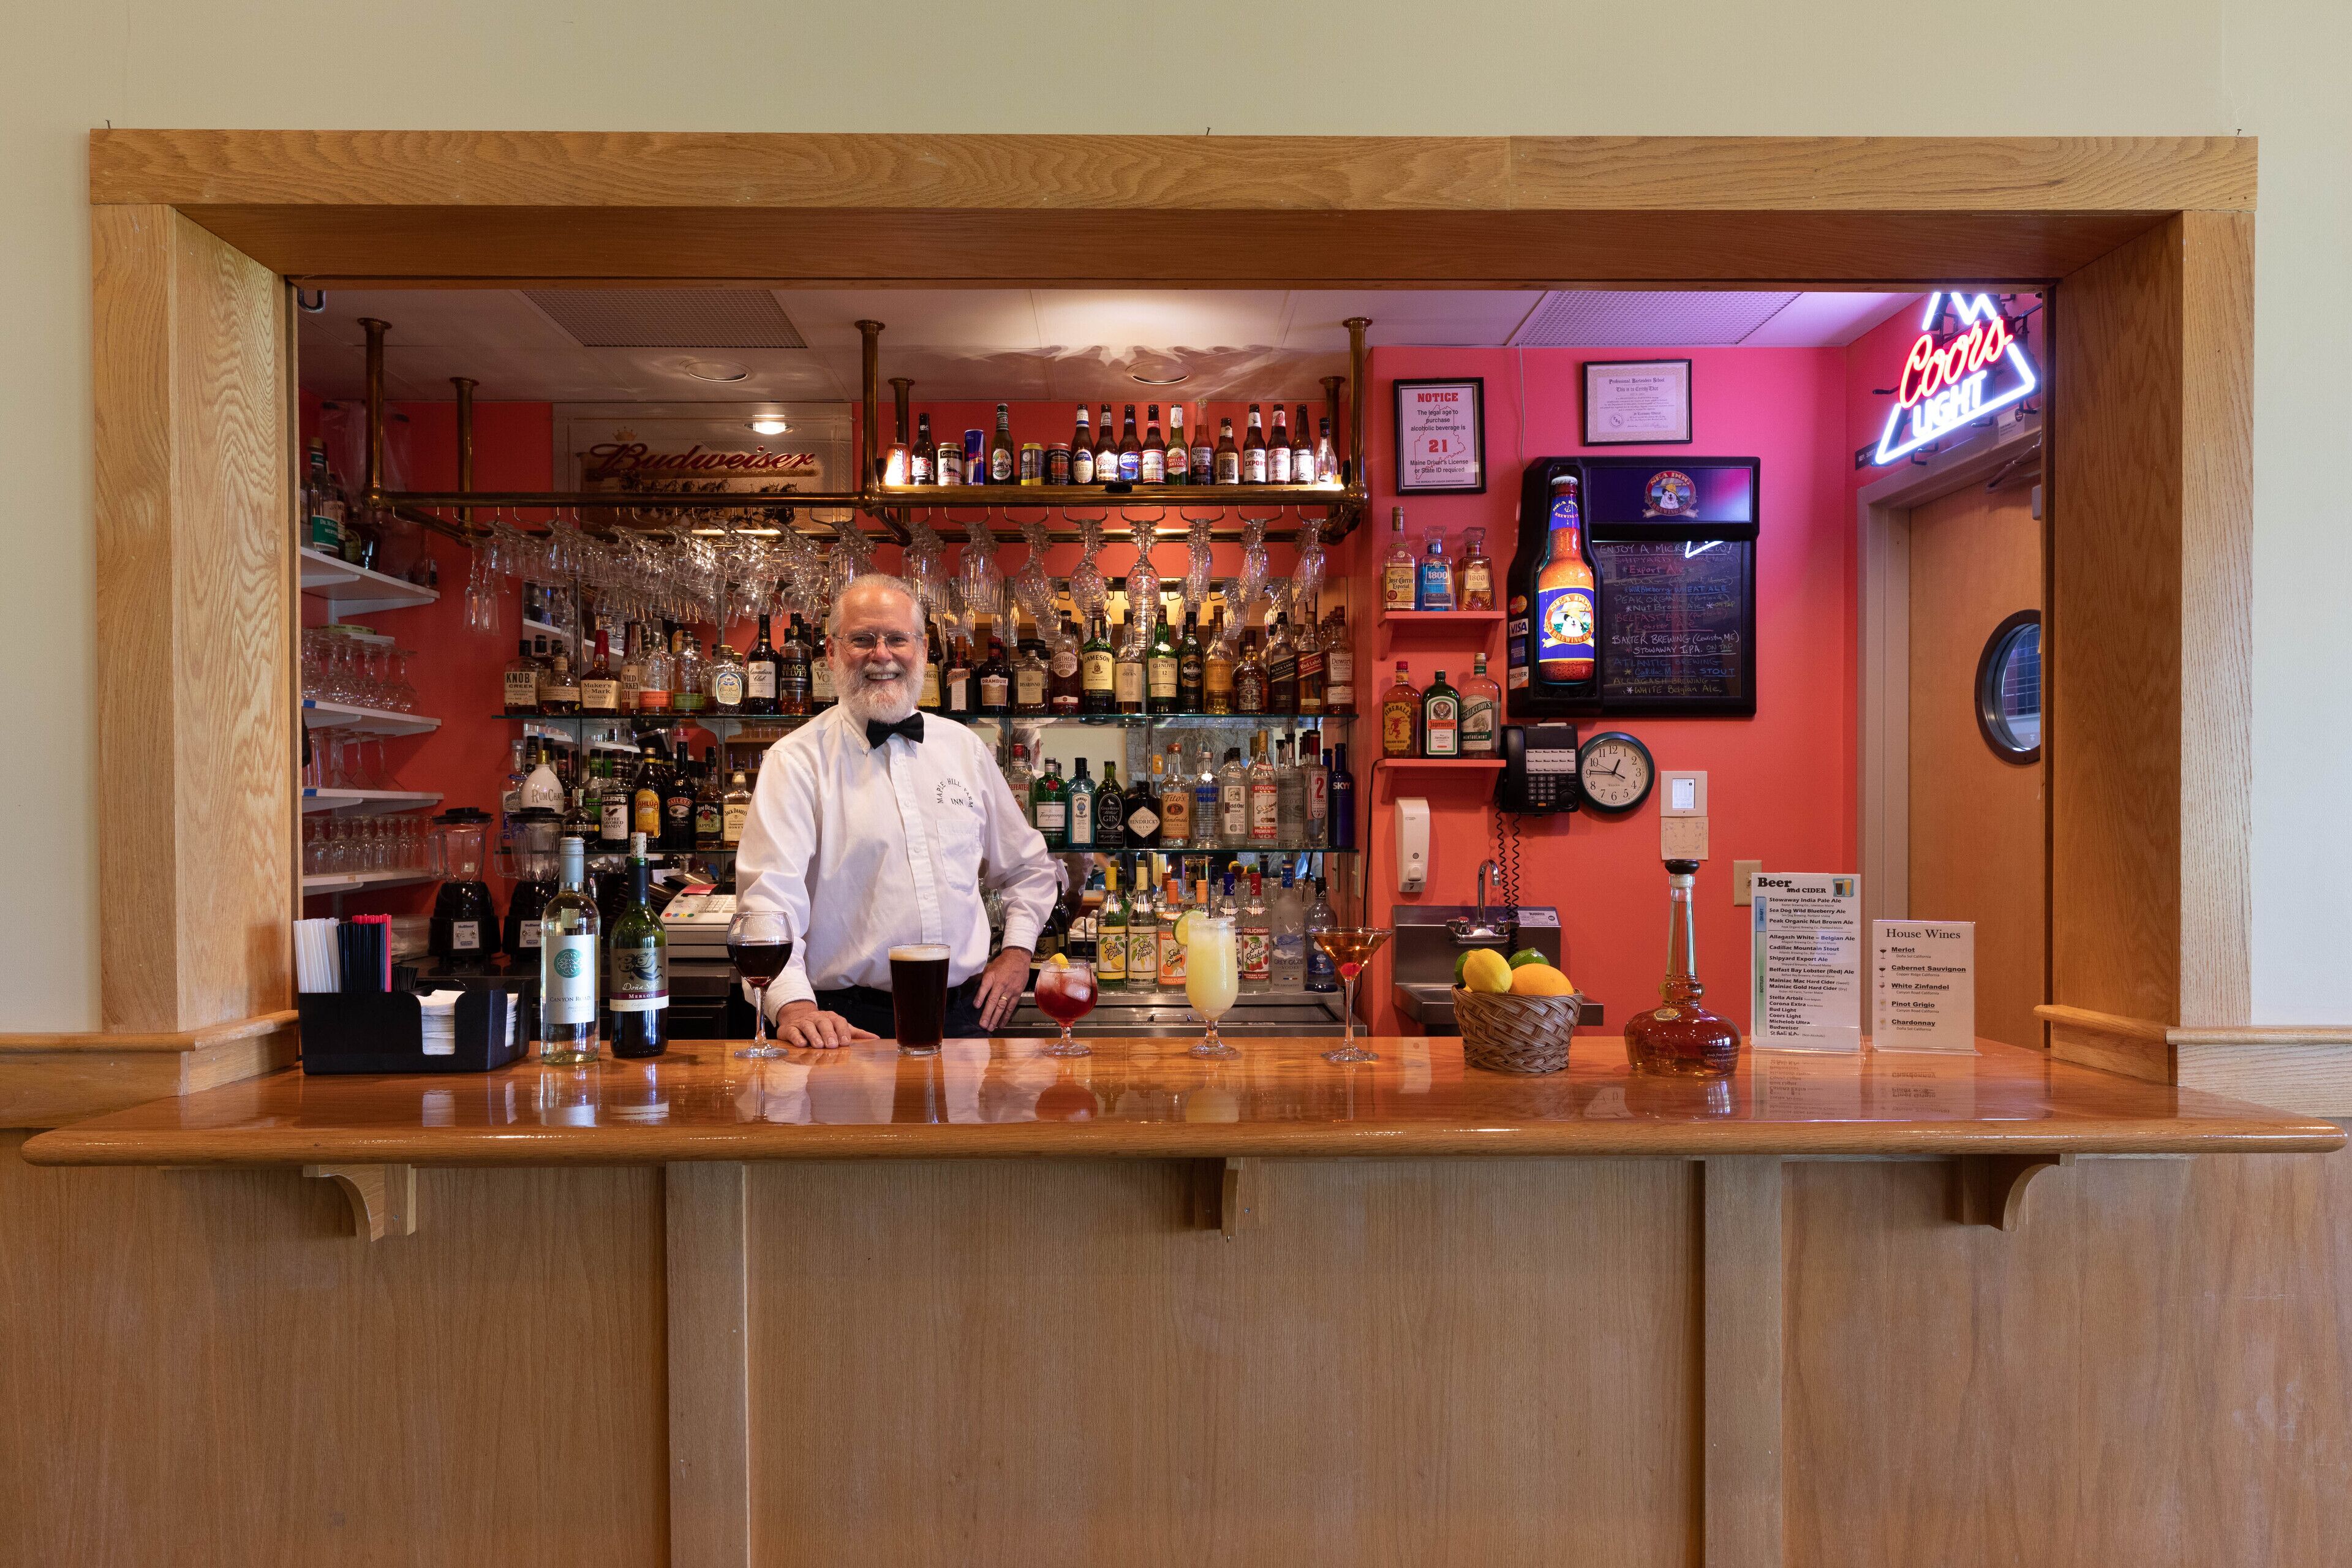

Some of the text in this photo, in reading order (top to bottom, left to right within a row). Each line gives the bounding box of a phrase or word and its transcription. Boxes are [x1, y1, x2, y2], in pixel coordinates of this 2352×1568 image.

[1900, 316, 2014, 408] Coors
[1417, 393, 1458, 402] NOTICE
[1912, 370, 1988, 438] LIGHT
[1428, 440, 1447, 452] 21
[590, 442, 815, 473] Budweiser
[1651, 472, 1691, 486] SEA DOG
[1652, 503, 1678, 514] BREWING
[1599, 545, 1649, 554] ENJOY A
[1550, 596, 1572, 611] SEA
[1511, 622, 1527, 634] VISA
[1552, 631, 1582, 643] BREWING
[1612, 635, 1648, 644] BAXTER
[1651, 634, 1691, 644] BREWING
[1724, 630, 1739, 643] ME)
[506, 673, 530, 684] KNOB
[1668, 685, 1697, 695] Belgian
[1384, 706, 1411, 717] FIREBALL
[1599, 749, 1605, 758] 11
[1608, 745, 1618, 754] 12
[1590, 758, 1599, 766] 10
[1632, 756, 1637, 766] 2
[1586, 769, 1591, 778] 9
[1636, 768, 1641, 777] 3
[1315, 777, 1324, 799] 2
[1590, 781, 1596, 790] 8
[1631, 781, 1637, 790] 4
[937, 781, 946, 804] MAPLE
[947, 778, 961, 787] HILL
[1600, 790, 1605, 798] 7
[1623, 790, 1629, 798] 5
[1611, 792, 1617, 801] 6
[1757, 878, 1792, 887] Beer
[1886, 929, 1961, 939] House Wines
[622, 982, 644, 992] Doña
